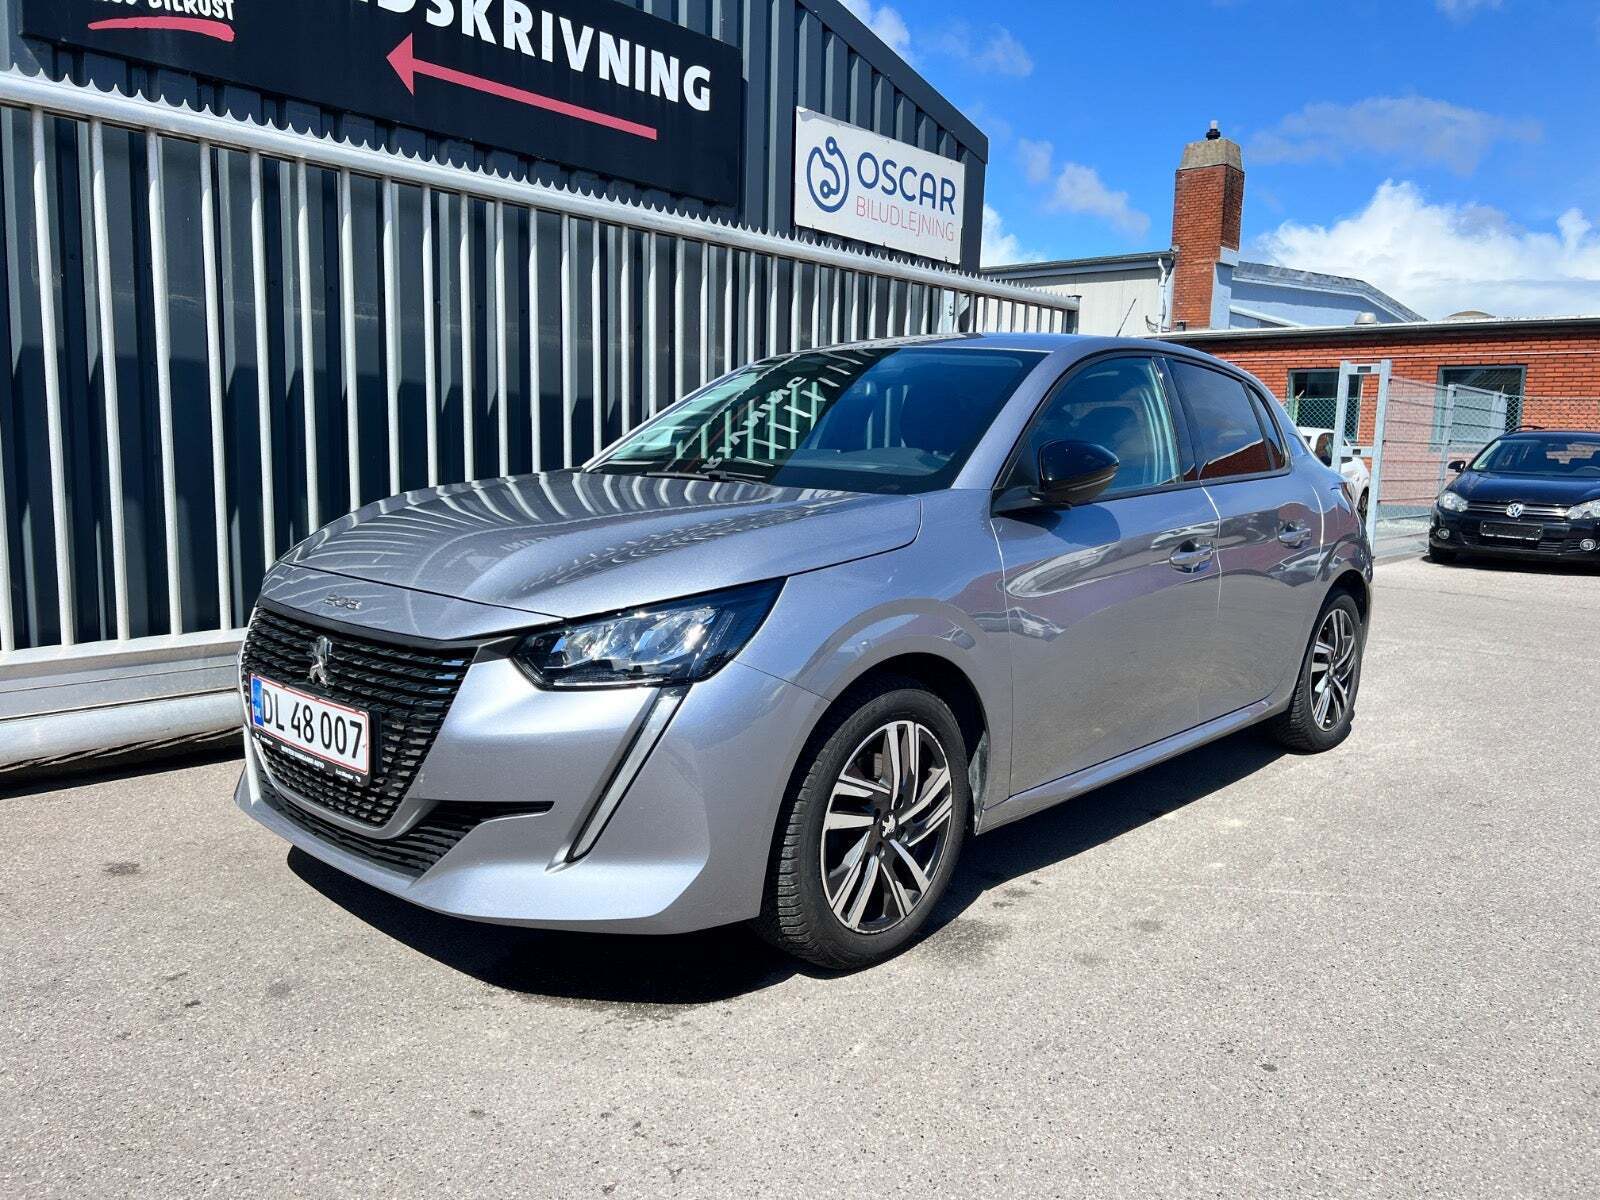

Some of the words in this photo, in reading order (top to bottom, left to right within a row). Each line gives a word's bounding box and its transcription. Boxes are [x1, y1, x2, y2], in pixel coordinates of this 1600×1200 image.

[857, 152, 956, 215] OSCAR
[856, 195, 954, 241] BILUDLEJNING
[263, 688, 285, 732] DL
[290, 701, 315, 744] 48
[320, 711, 363, 759] 007
